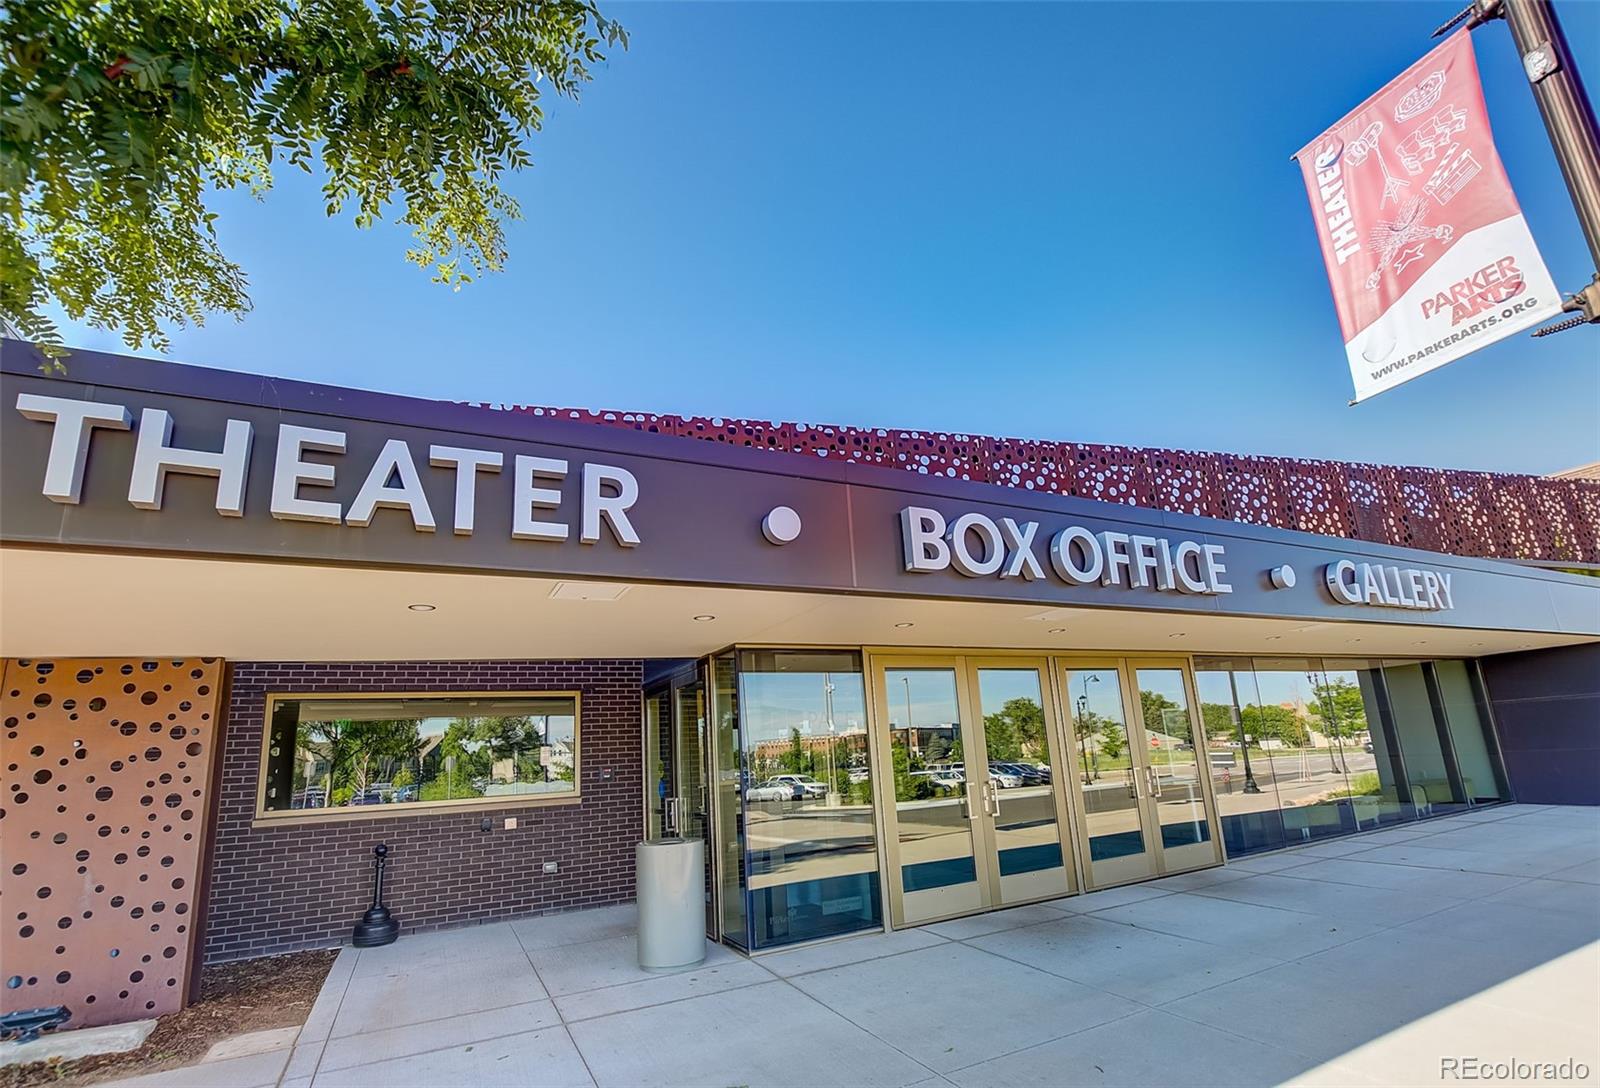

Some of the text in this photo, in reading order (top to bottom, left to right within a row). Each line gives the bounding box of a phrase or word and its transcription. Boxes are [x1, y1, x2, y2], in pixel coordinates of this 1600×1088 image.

[1315, 143, 1361, 265] THEATER
[1421, 255, 1521, 319] PARKER
[1451, 273, 1527, 326] ARTS
[1371, 297, 1538, 380] WWW.PARKERARTS.ORG
[16, 393, 1455, 611] THEATER BOX OFFICE GALLERY
